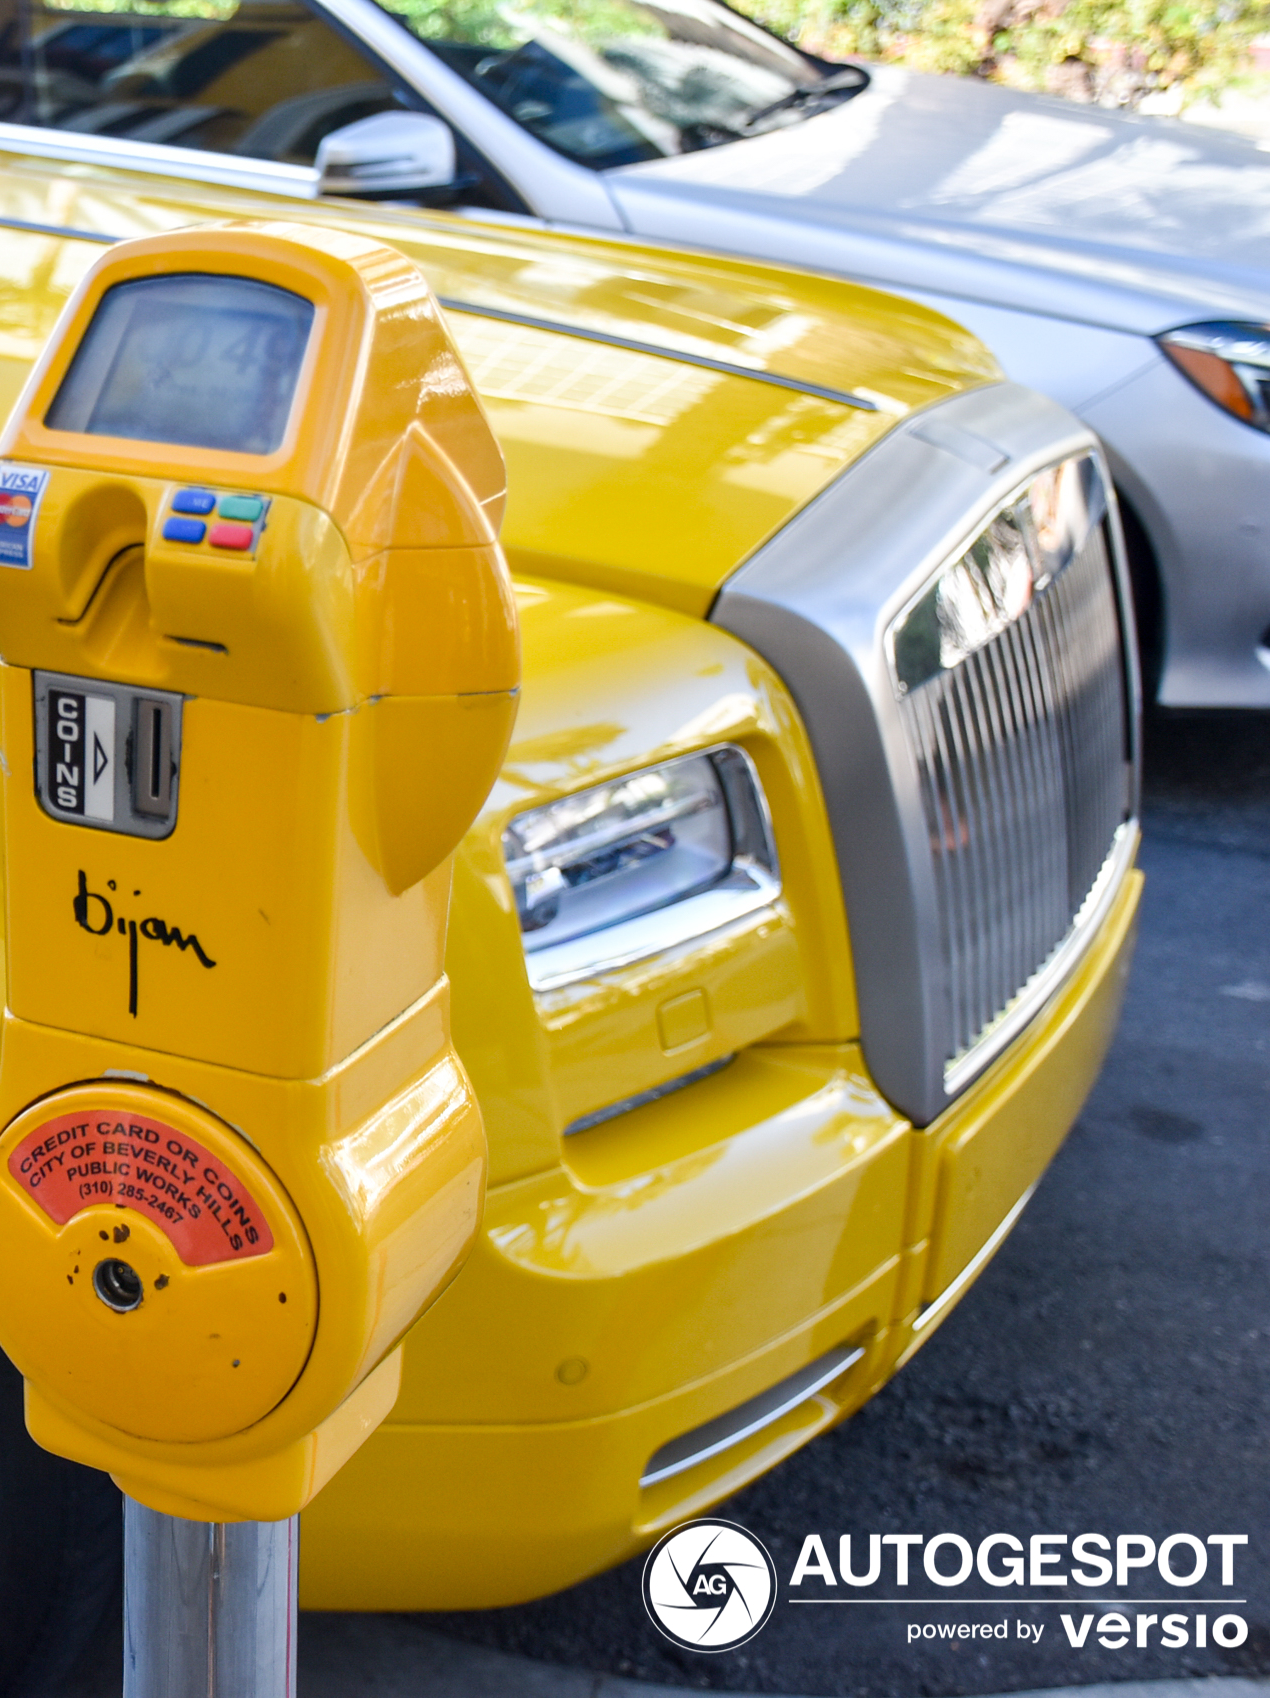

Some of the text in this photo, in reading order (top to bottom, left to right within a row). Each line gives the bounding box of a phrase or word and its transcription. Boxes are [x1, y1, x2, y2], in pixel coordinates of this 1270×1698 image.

[1, 472, 38, 490] VISA
[56, 697, 79, 808] COINS
[73, 869, 217, 1019] bijan
[20, 1122, 259, 1245] CREDIT CARD OR COINS
[29, 1141, 244, 1251] CITY OF BEVERLY HILLS
[66, 1161, 201, 1219] PUBLIC WORKS
[79, 1180, 184, 1224] (310) 285-2467
